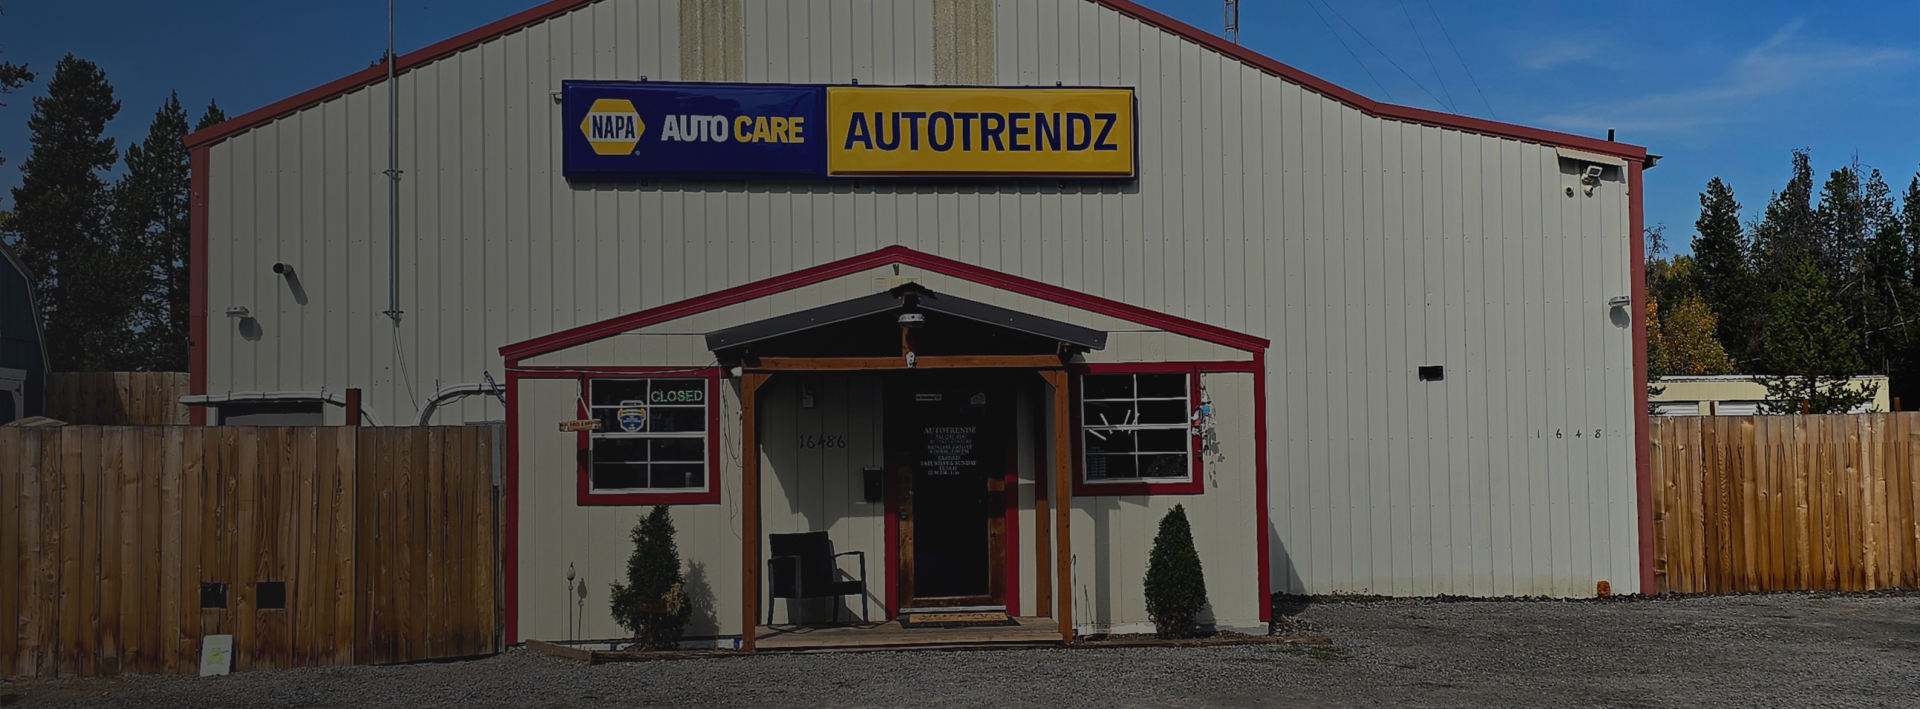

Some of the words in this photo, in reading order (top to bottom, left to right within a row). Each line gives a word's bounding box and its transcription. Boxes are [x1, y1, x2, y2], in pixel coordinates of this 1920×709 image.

[592, 114, 636, 139] NAPA
[661, 114, 729, 142] AUTO
[733, 115, 805, 143] CARE
[844, 111, 1118, 152] AUTOTRENDZ
[650, 390, 703, 403] CLOSED
[799, 433, 846, 449] 16486
